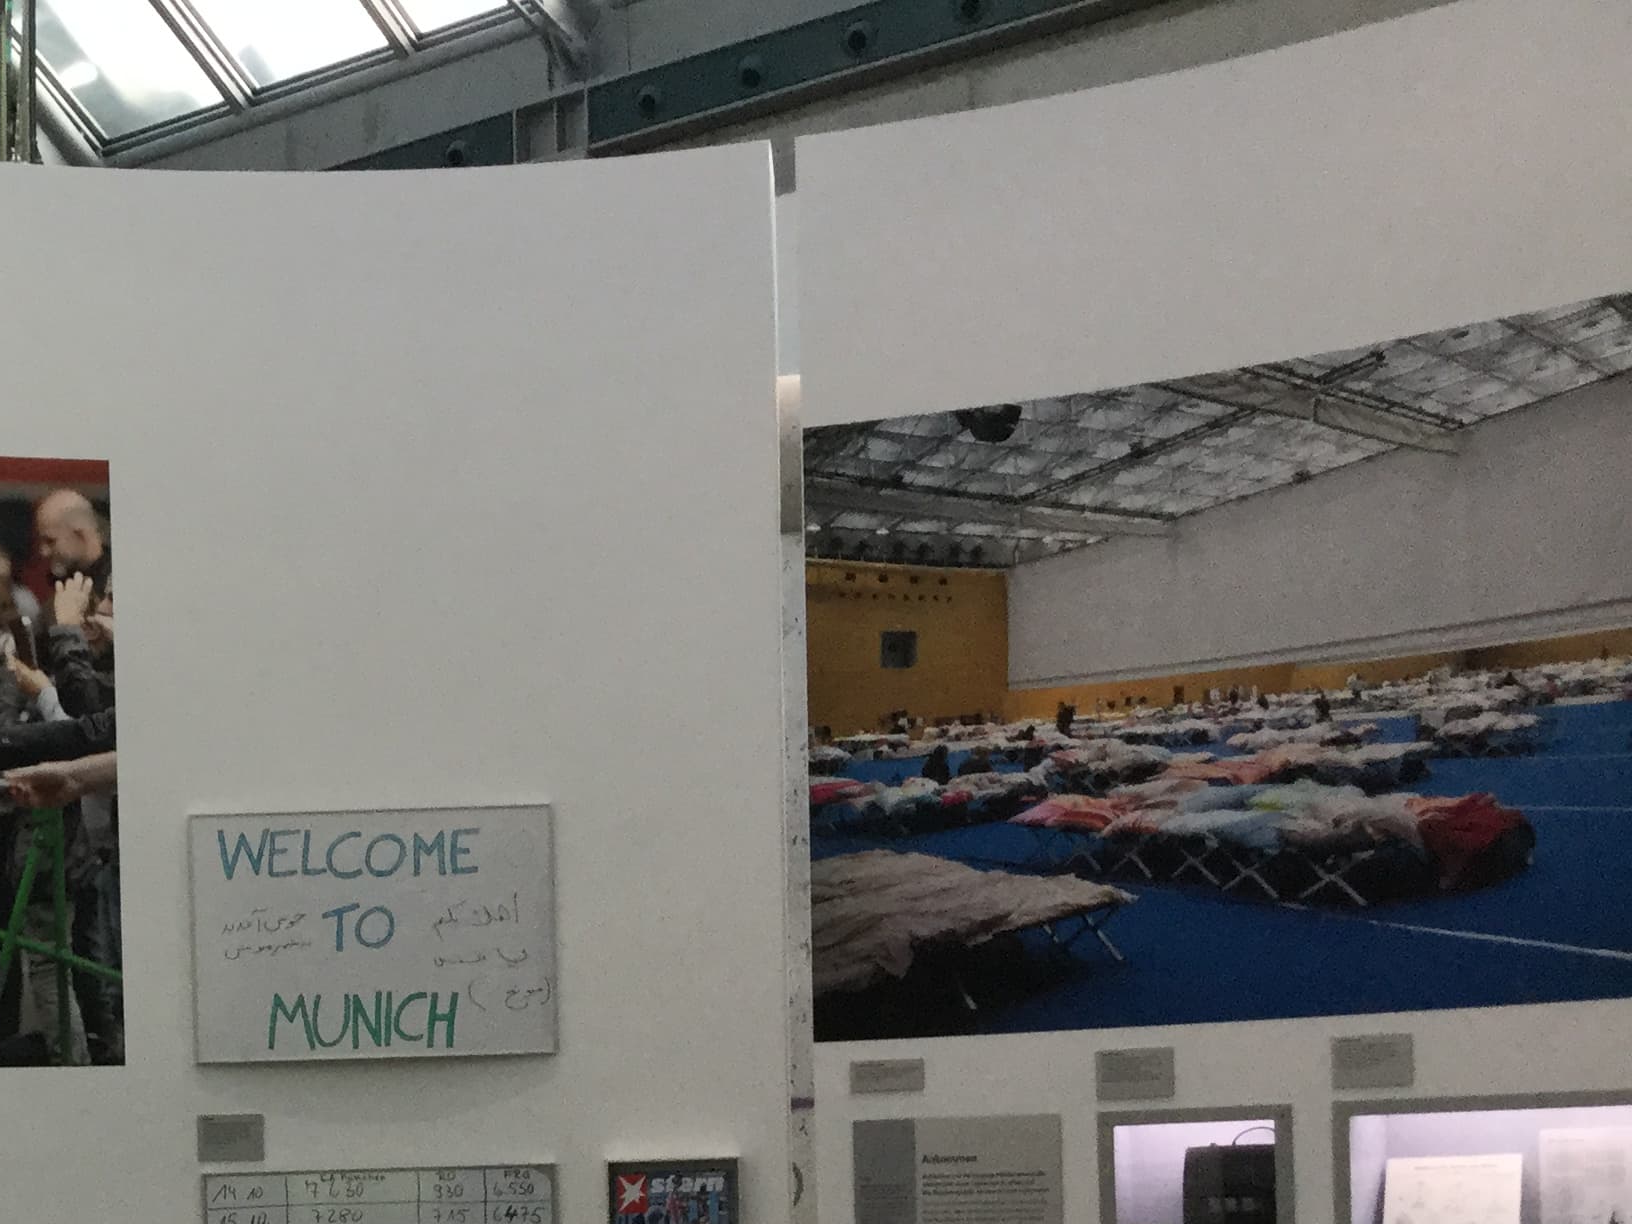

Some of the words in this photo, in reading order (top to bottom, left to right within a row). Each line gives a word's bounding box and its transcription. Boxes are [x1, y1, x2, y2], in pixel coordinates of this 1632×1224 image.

[217, 827, 481, 881] WELCOME
[322, 902, 396, 952] TO
[268, 990, 459, 1051] MUNICH
[649, 1174, 726, 1194] stern
